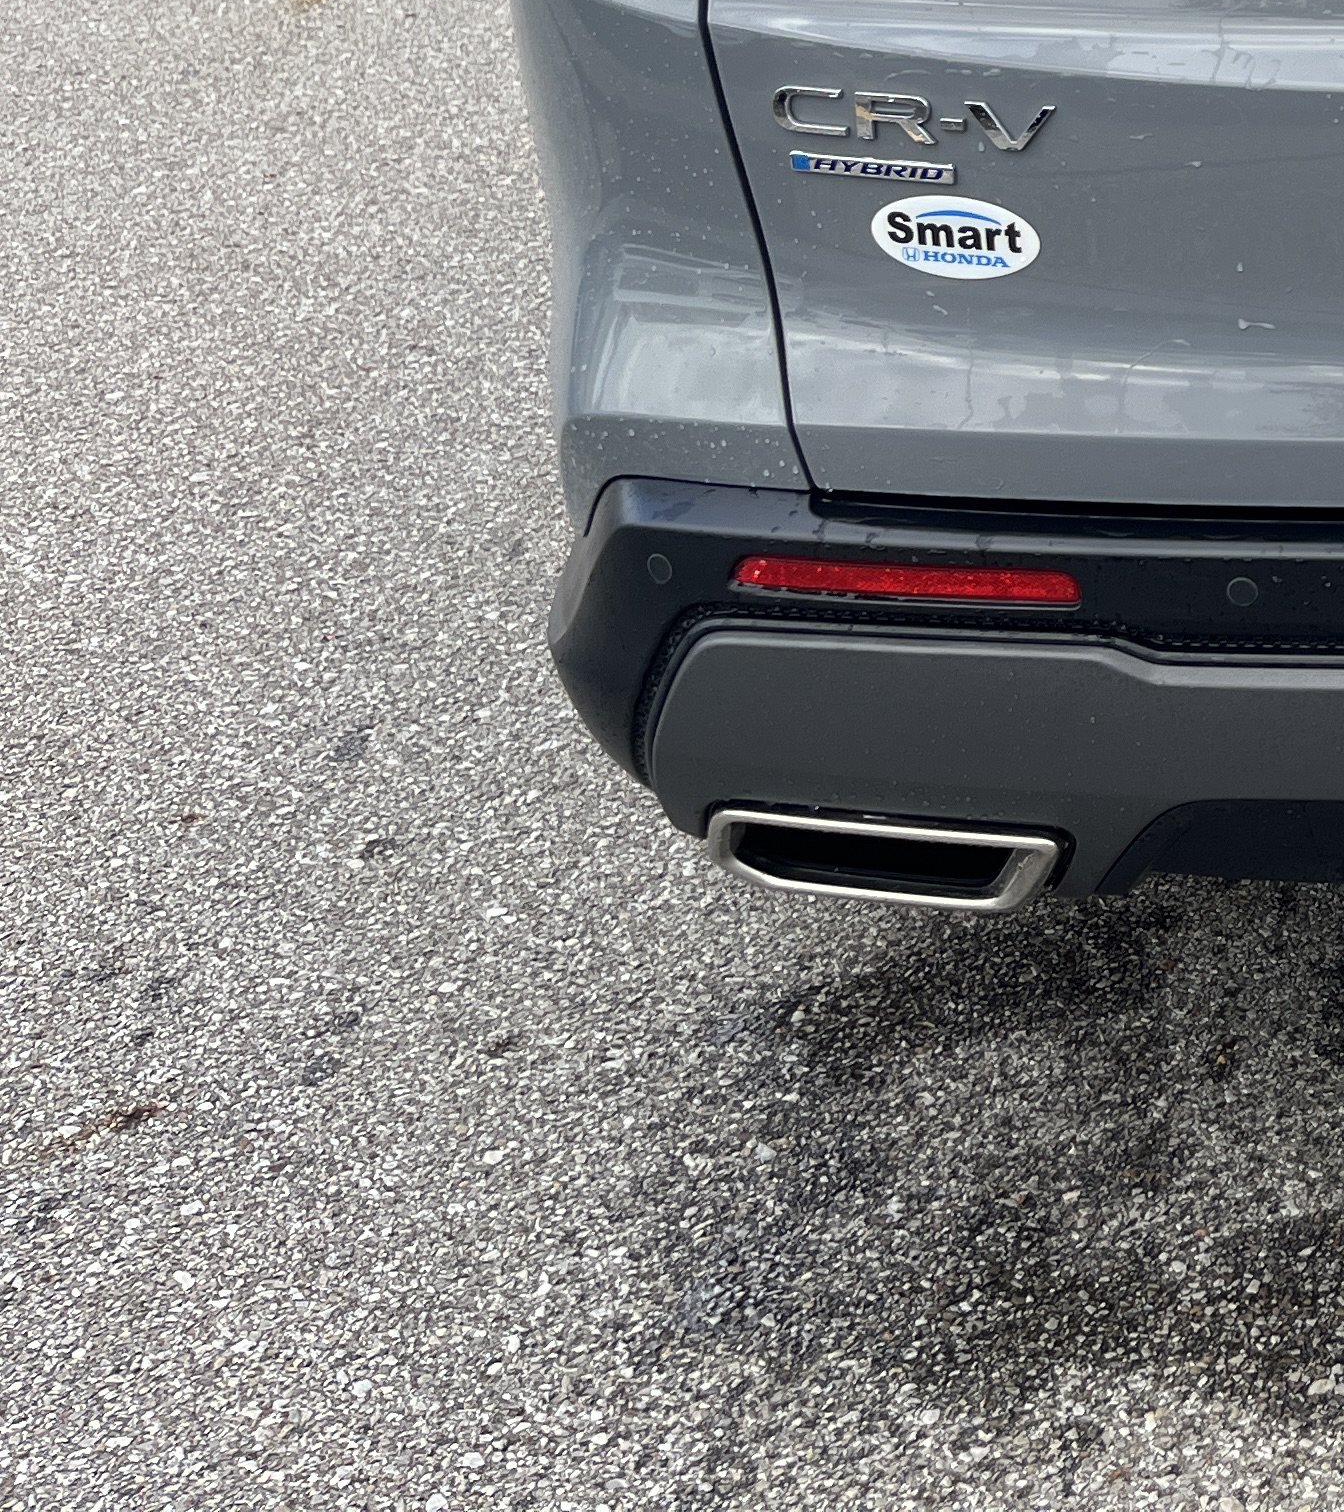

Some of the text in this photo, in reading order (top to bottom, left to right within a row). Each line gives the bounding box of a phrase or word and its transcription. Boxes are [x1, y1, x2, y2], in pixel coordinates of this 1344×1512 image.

[773, 85, 1057, 152] CR-V
[813, 157, 945, 180] HYBRID
[887, 211, 1023, 253] Smart
[922, 250, 1011, 268] HONDA
